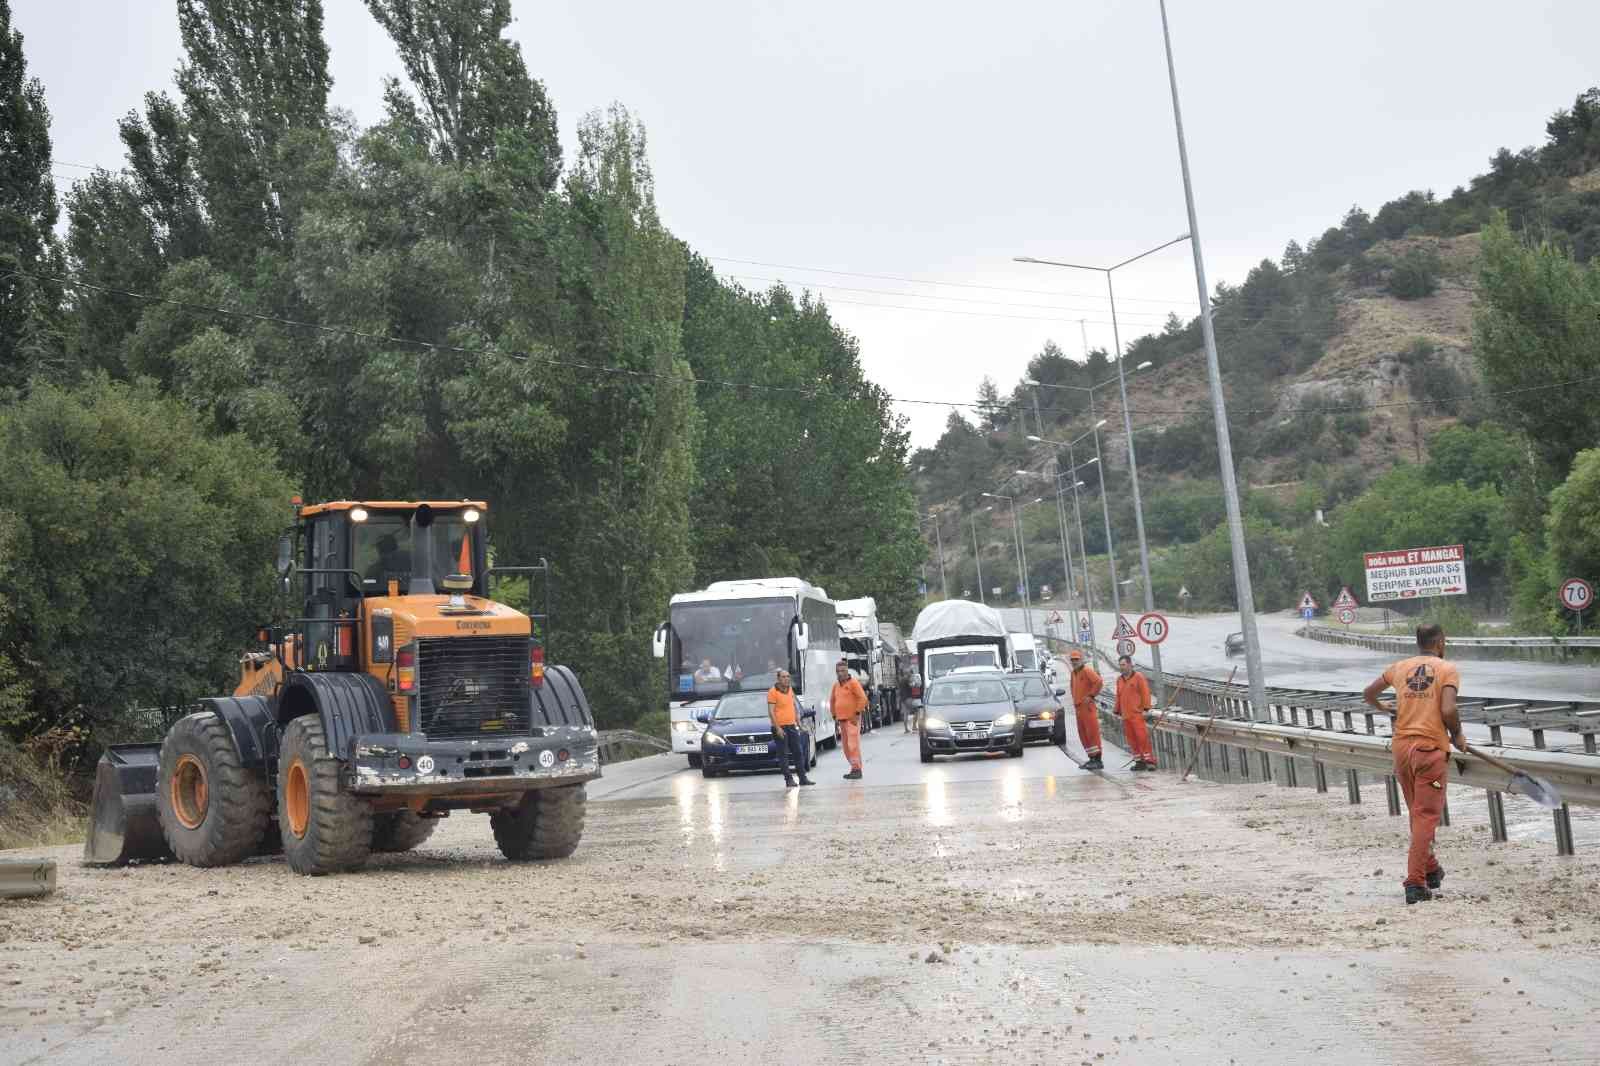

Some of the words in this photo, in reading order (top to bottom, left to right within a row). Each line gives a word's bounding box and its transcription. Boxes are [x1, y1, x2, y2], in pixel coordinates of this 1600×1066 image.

[1407, 551, 1419, 562] ET
[1421, 548, 1460, 562] MANGAL
[1370, 567, 1407, 579] MEŞHUR
[1409, 565, 1445, 576] BURDUR
[1372, 580, 1413, 591] SERPME
[1415, 575, 1461, 587] KAHVALTI
[1567, 586, 1586, 601] 70
[1144, 621, 1162, 636] 70
[418, 759, 433, 770] 40
[541, 753, 553, 765] 40
